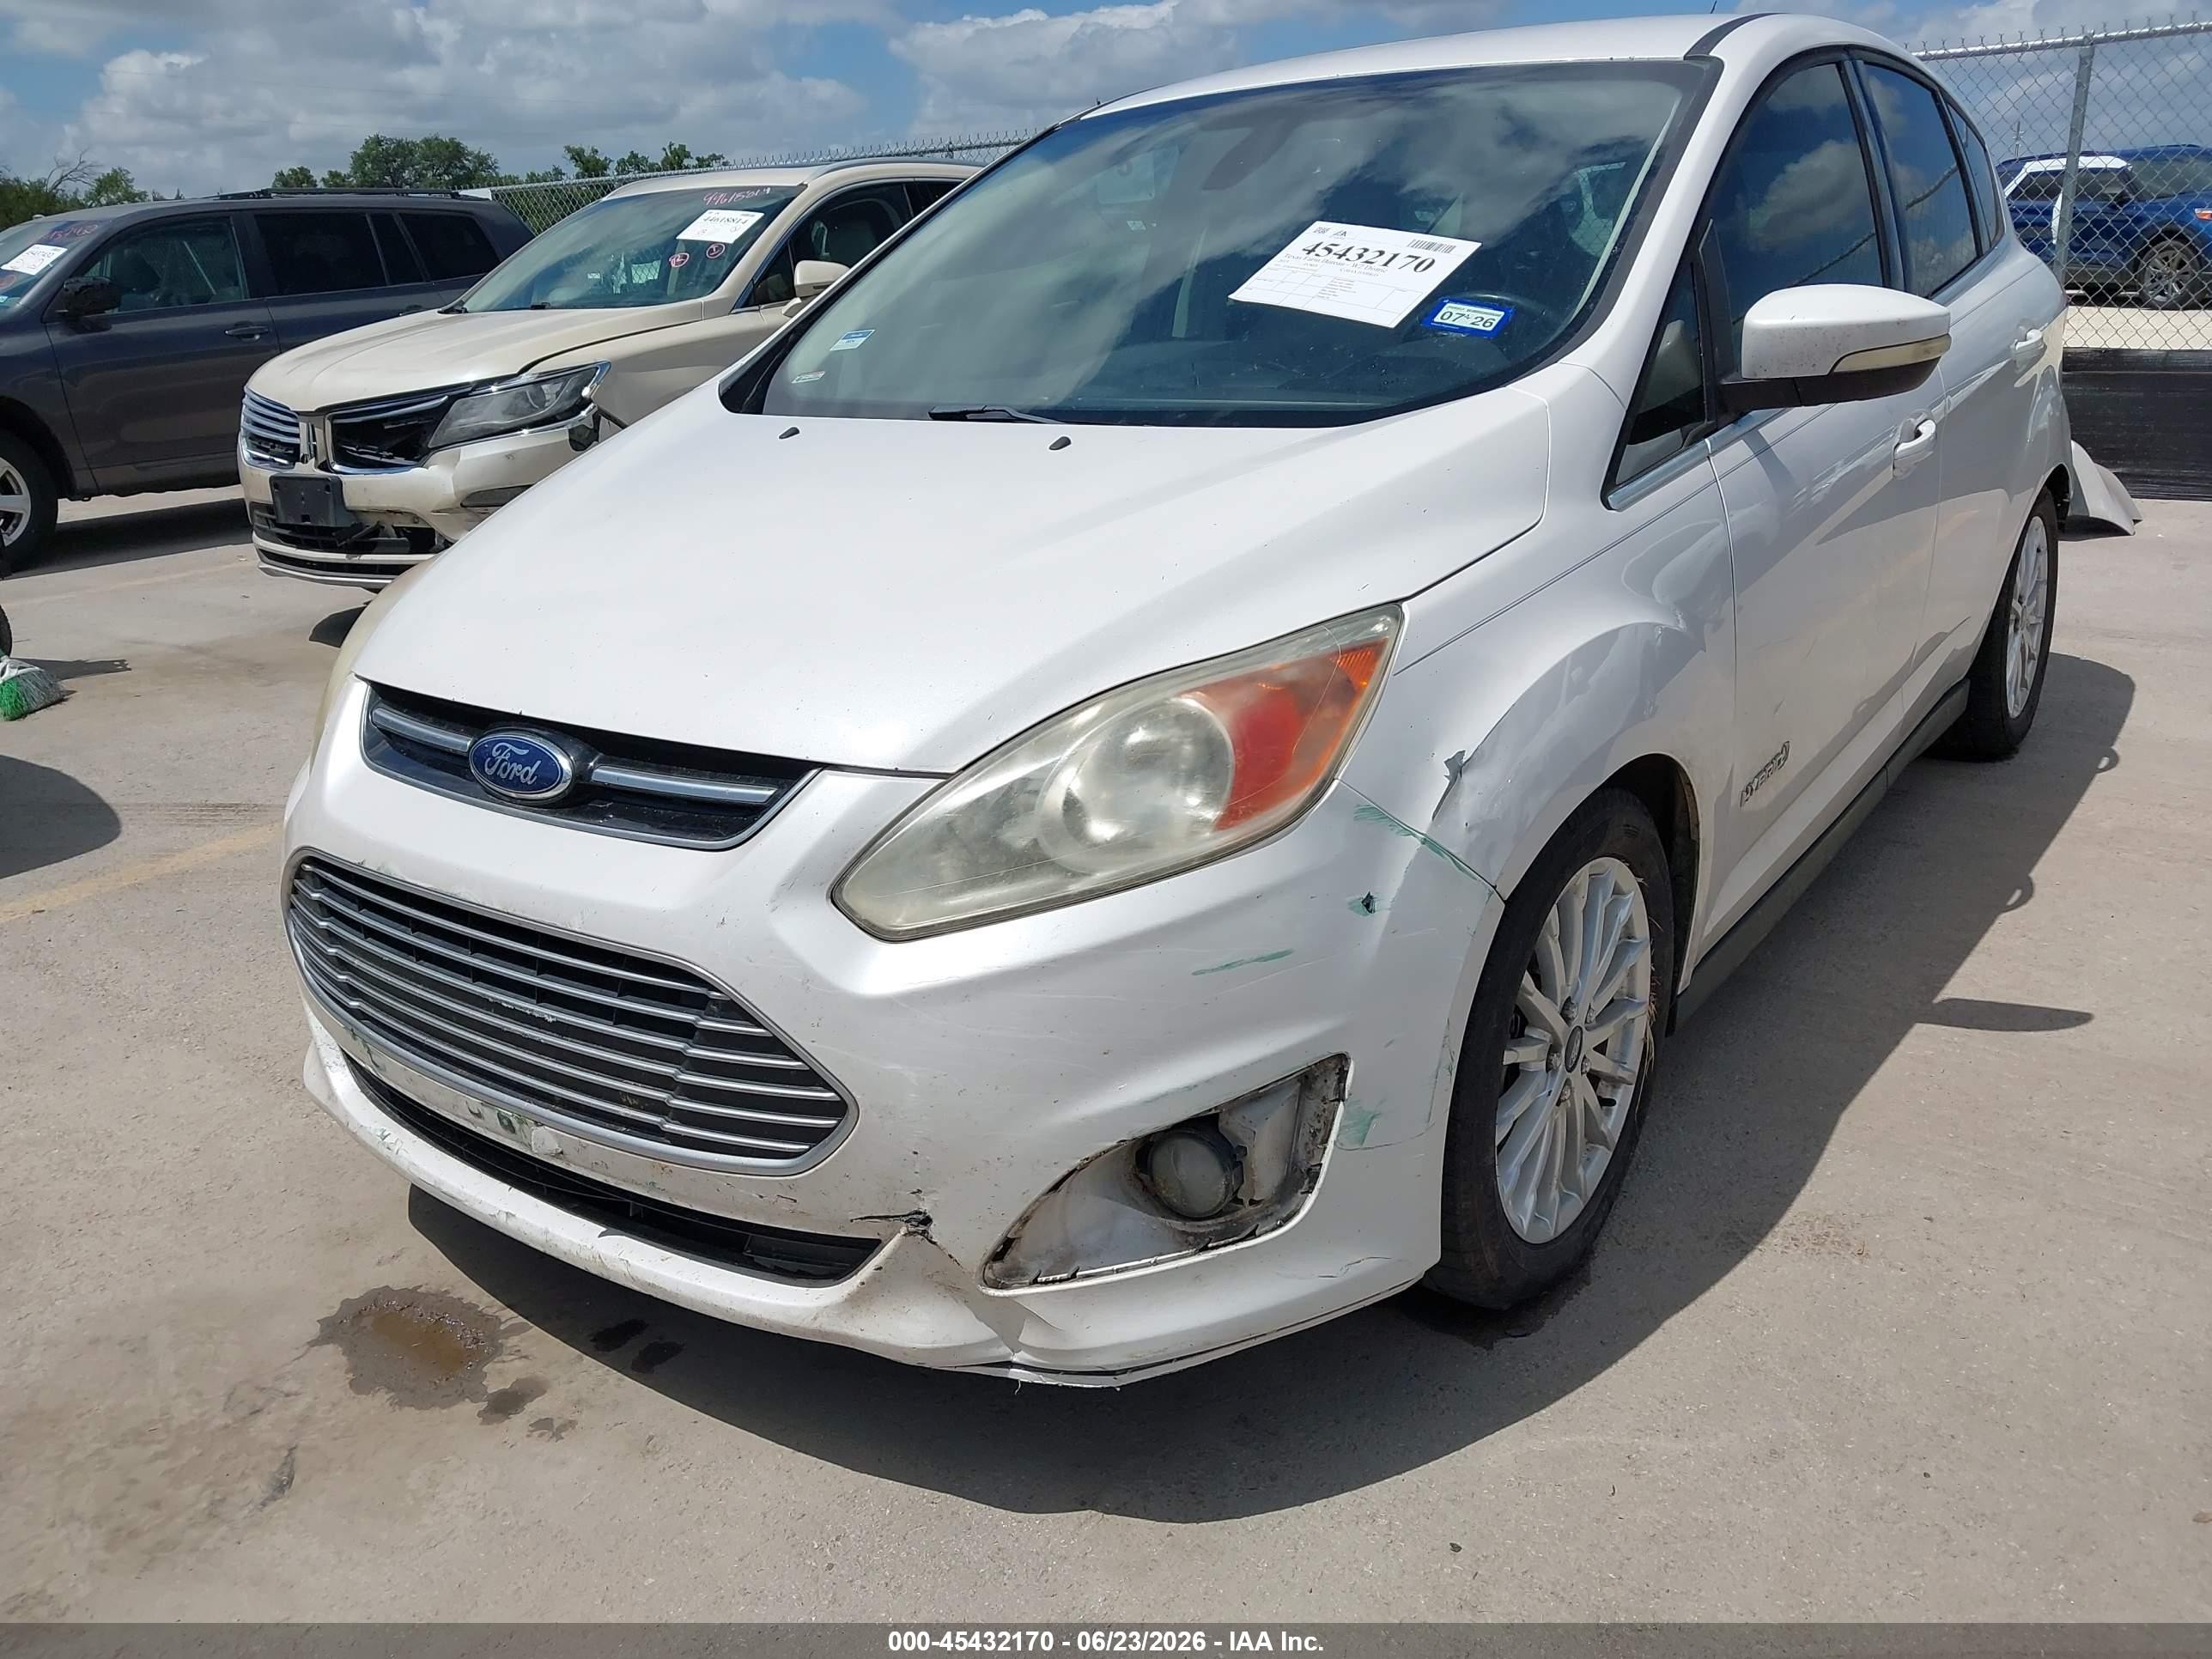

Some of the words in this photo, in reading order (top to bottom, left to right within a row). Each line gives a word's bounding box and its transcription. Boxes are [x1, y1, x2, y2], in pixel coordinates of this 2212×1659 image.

[1302, 241, 1436, 273] 45432170
[1440, 311, 1465, 322] 07
[1470, 316, 1496, 328] 26
[484, 742, 542, 785] Ford
